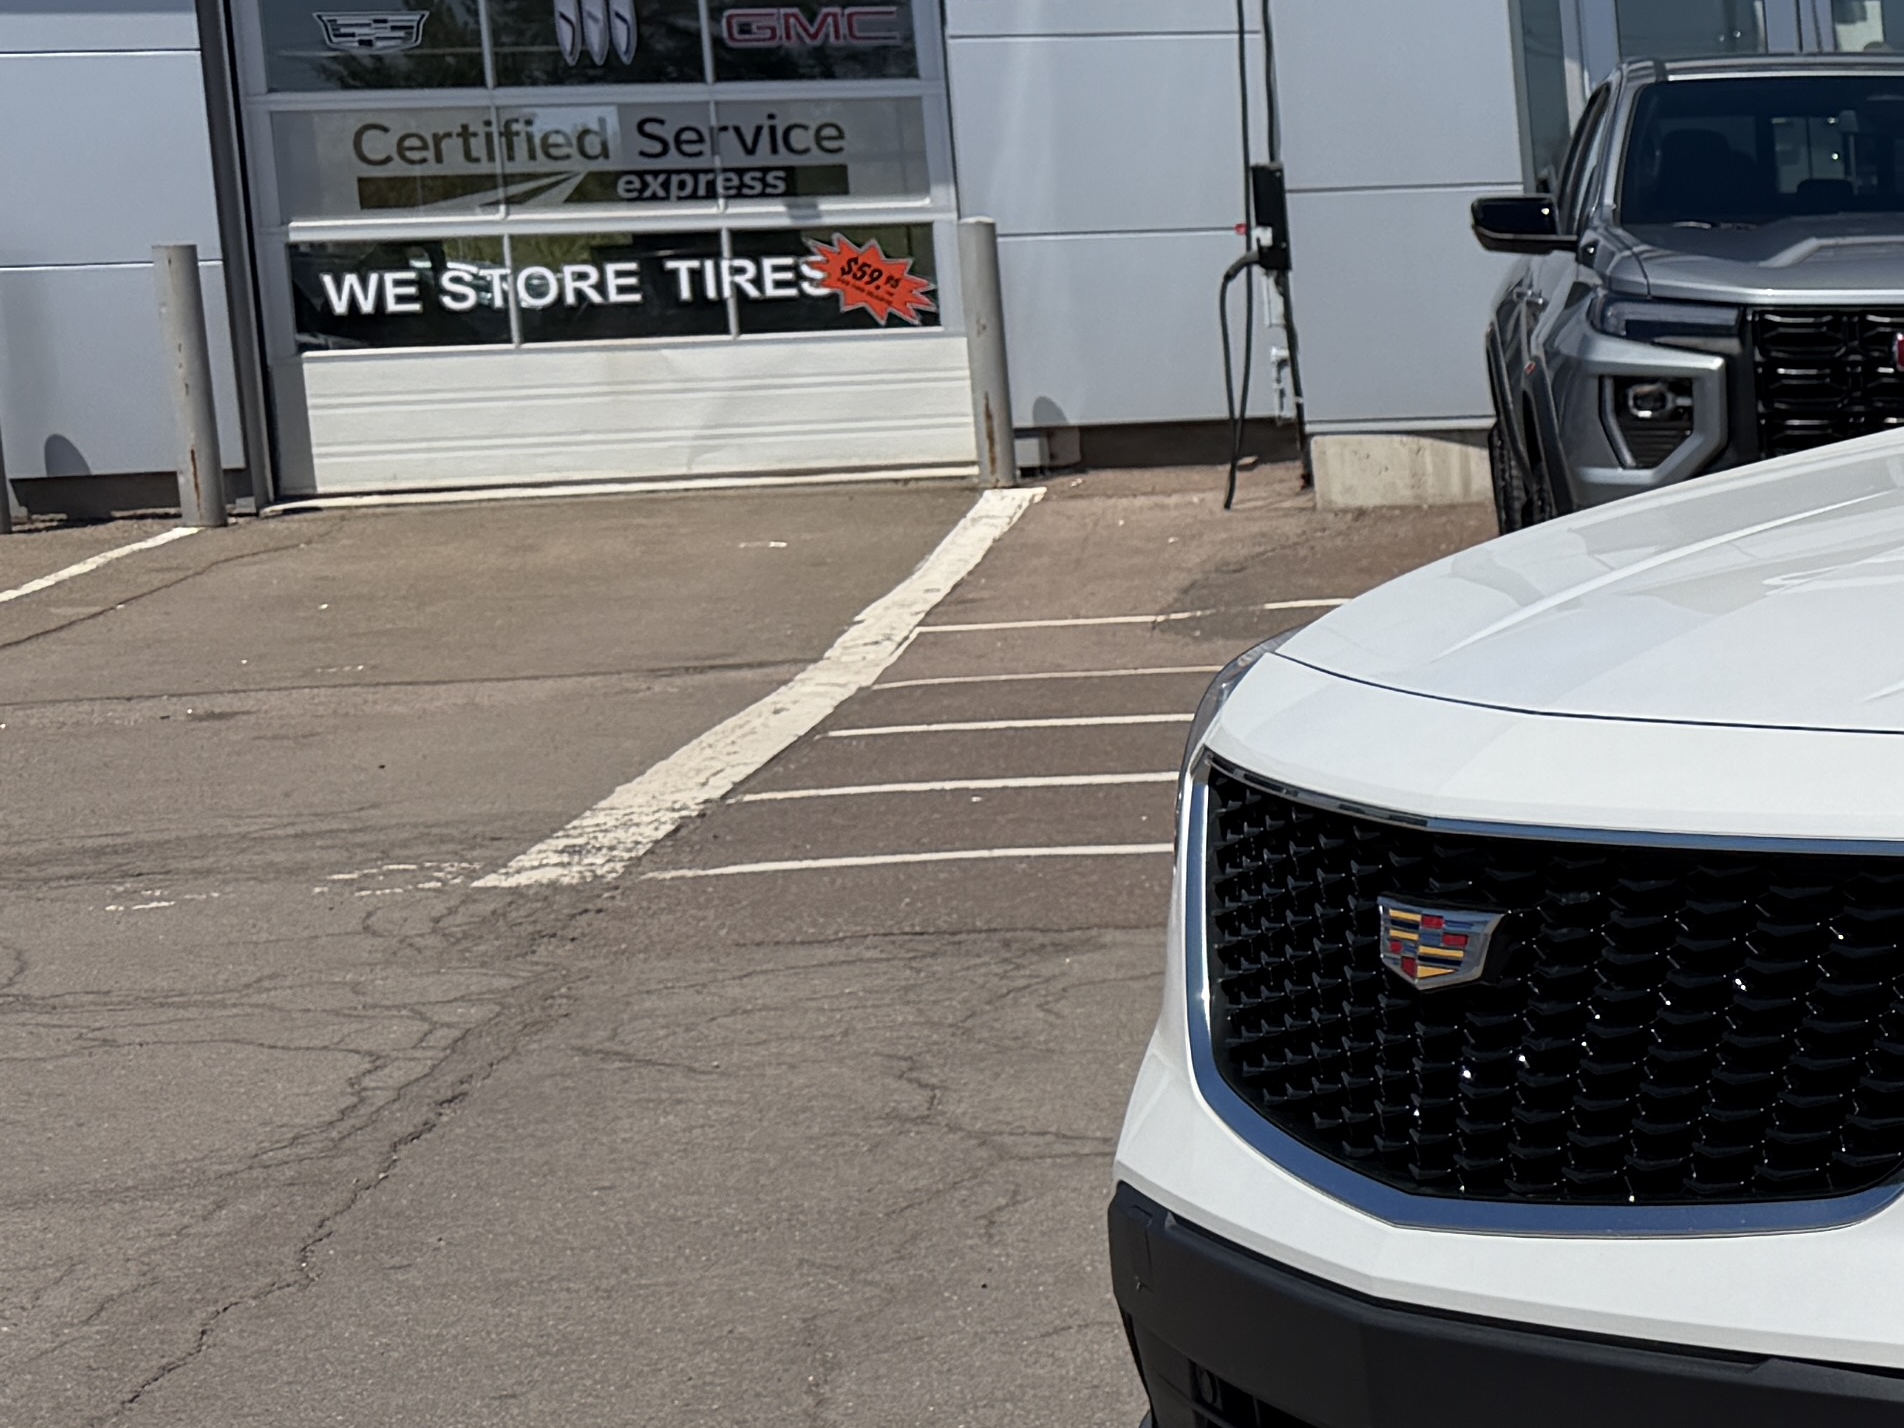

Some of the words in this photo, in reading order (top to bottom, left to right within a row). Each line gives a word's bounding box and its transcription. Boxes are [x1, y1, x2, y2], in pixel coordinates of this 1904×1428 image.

[722, 6, 898, 48] GMC
[352, 116, 611, 167] Certified
[636, 113, 846, 159] Service
[616, 169, 788, 202] express
[321, 271, 424, 316] WE
[440, 262, 642, 312] STORE
[664, 255, 833, 302] TIRES
